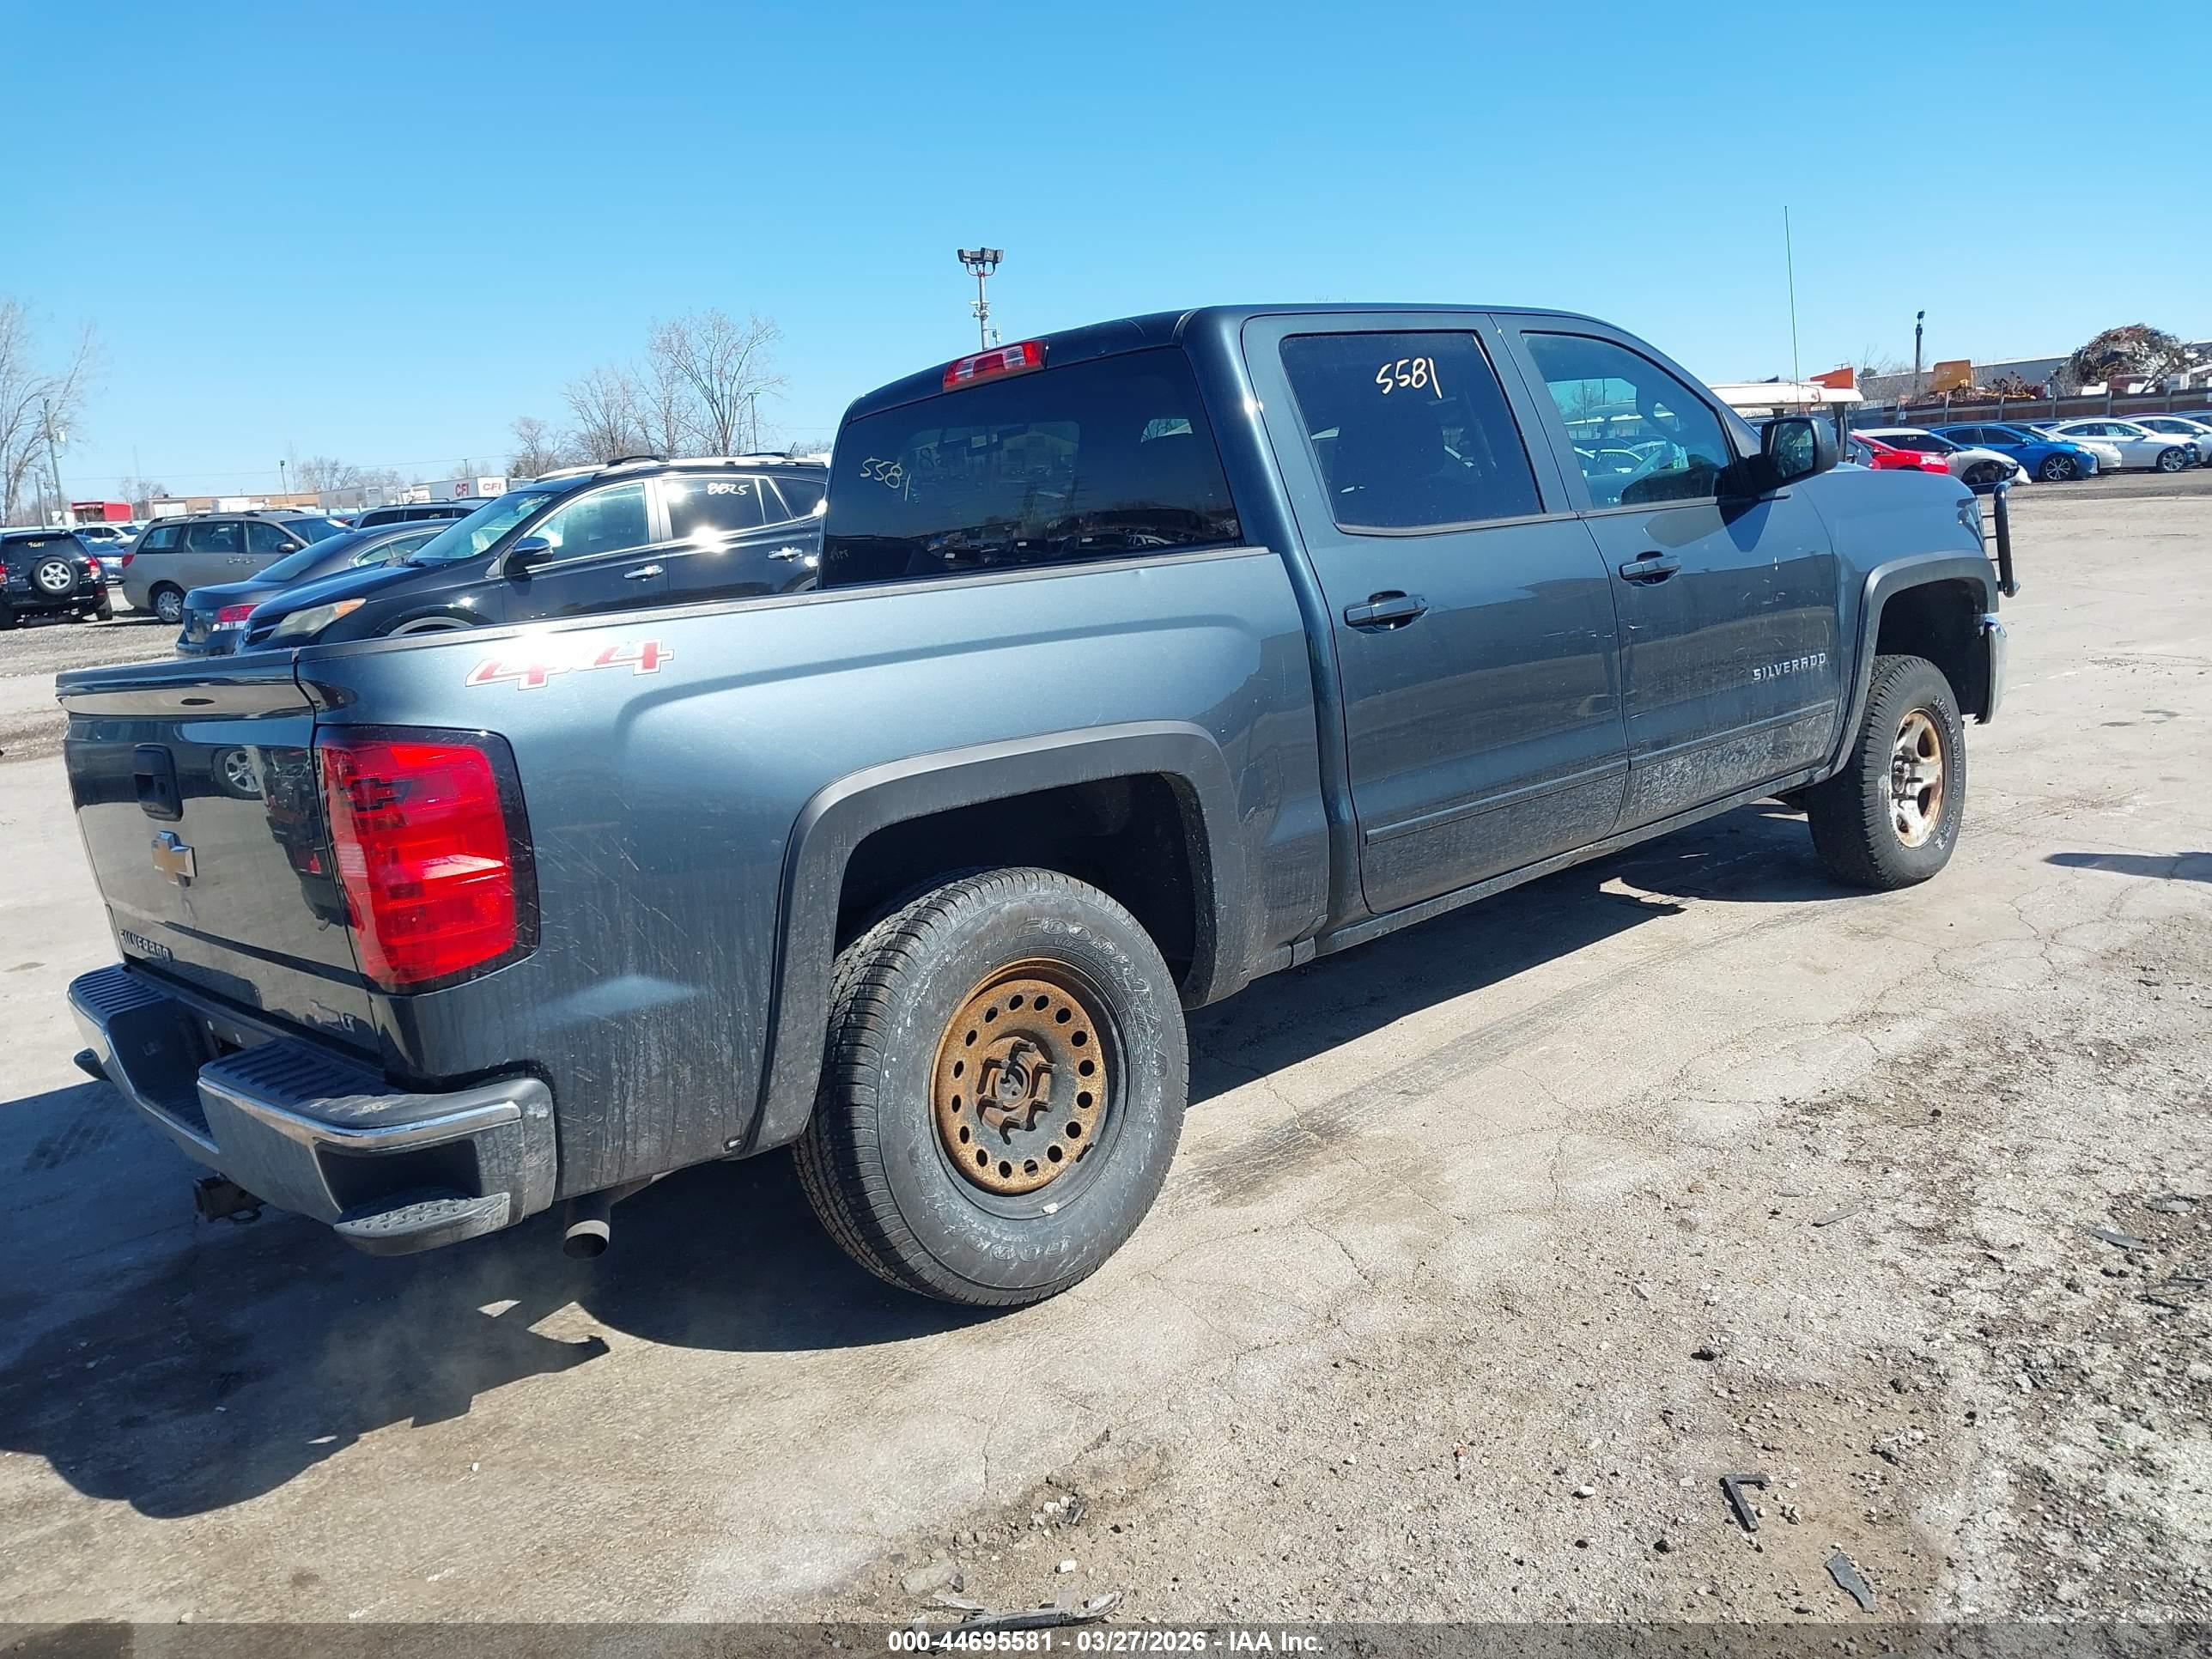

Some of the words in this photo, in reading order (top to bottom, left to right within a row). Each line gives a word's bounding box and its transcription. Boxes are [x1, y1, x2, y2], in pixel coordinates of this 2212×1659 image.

[1375, 356, 1443, 399] 5581
[455, 483, 470, 497] CFI
[483, 483, 501, 491] CFI
[860, 455, 912, 502] 5581
[465, 639, 674, 690] 44
[1753, 653, 1826, 681] SILVERADO
